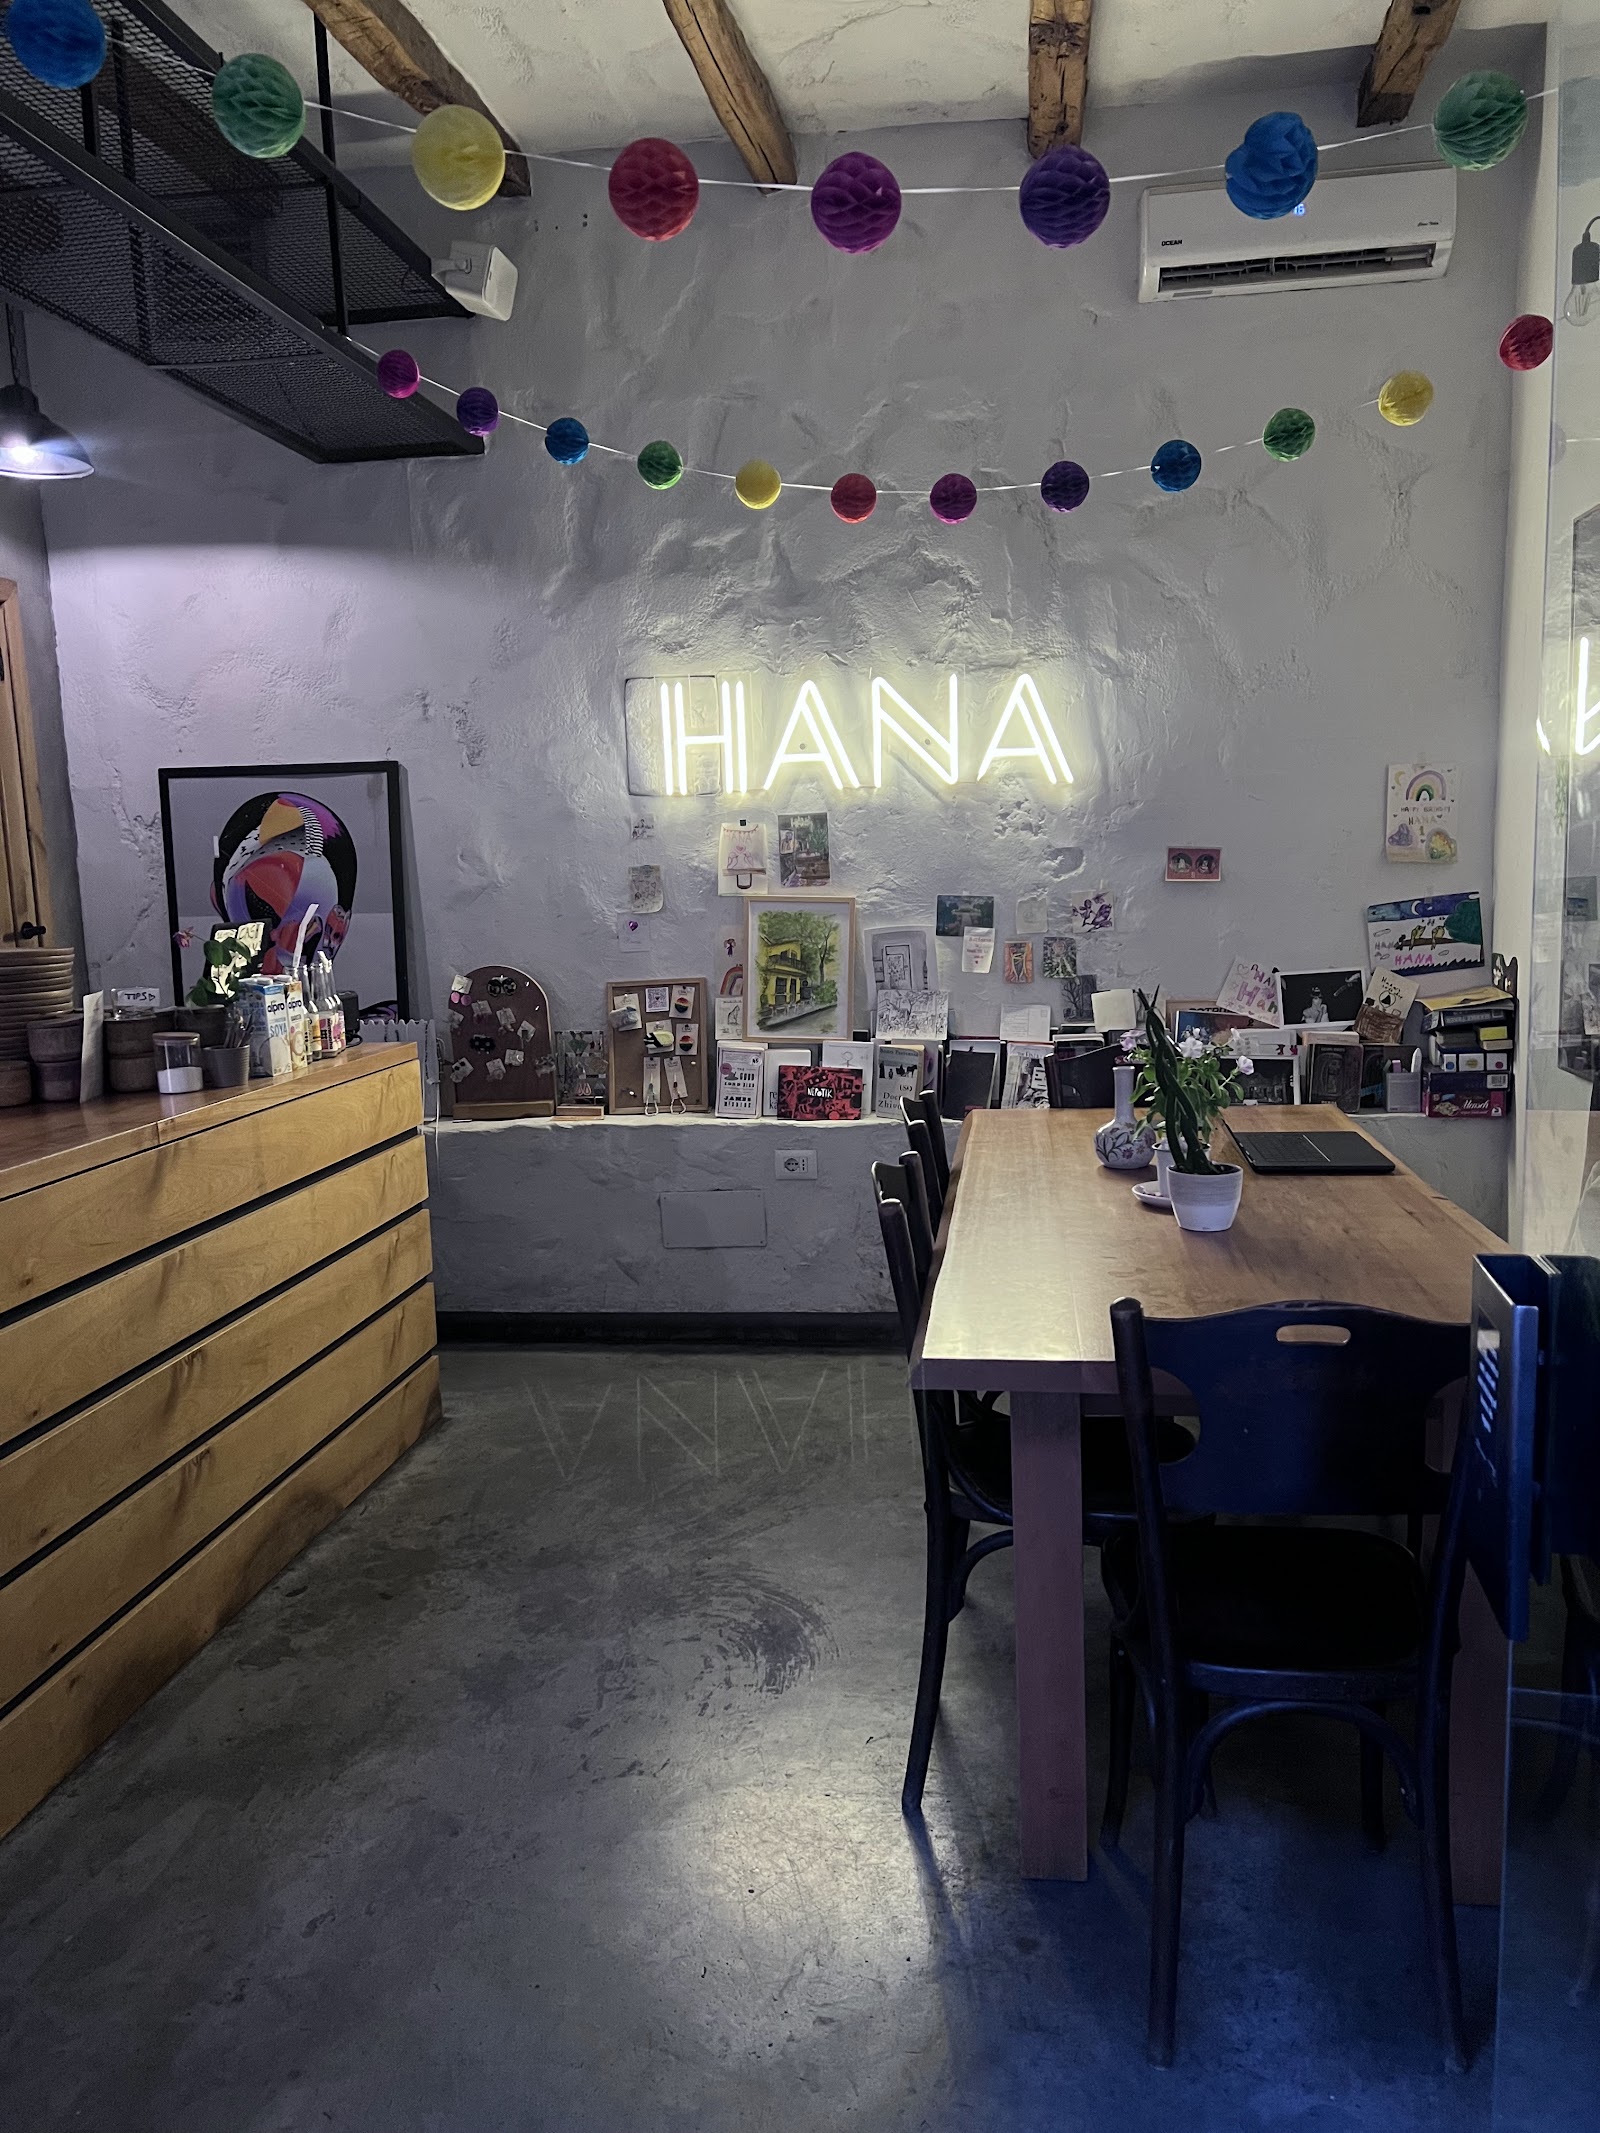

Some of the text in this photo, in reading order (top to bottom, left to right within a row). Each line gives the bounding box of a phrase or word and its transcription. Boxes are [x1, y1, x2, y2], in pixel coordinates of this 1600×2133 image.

[1161, 238, 1183, 247] OCEAN
[659, 672, 1076, 796] HANA
[1394, 953, 1434, 966] HANA
[124, 991, 147, 1001] TIPS
[267, 1000, 286, 1015] alpro
[288, 998, 302, 1011] alpro
[269, 1022, 287, 1037] SOYA
[1462, 1099, 1491, 1110] Mensch
